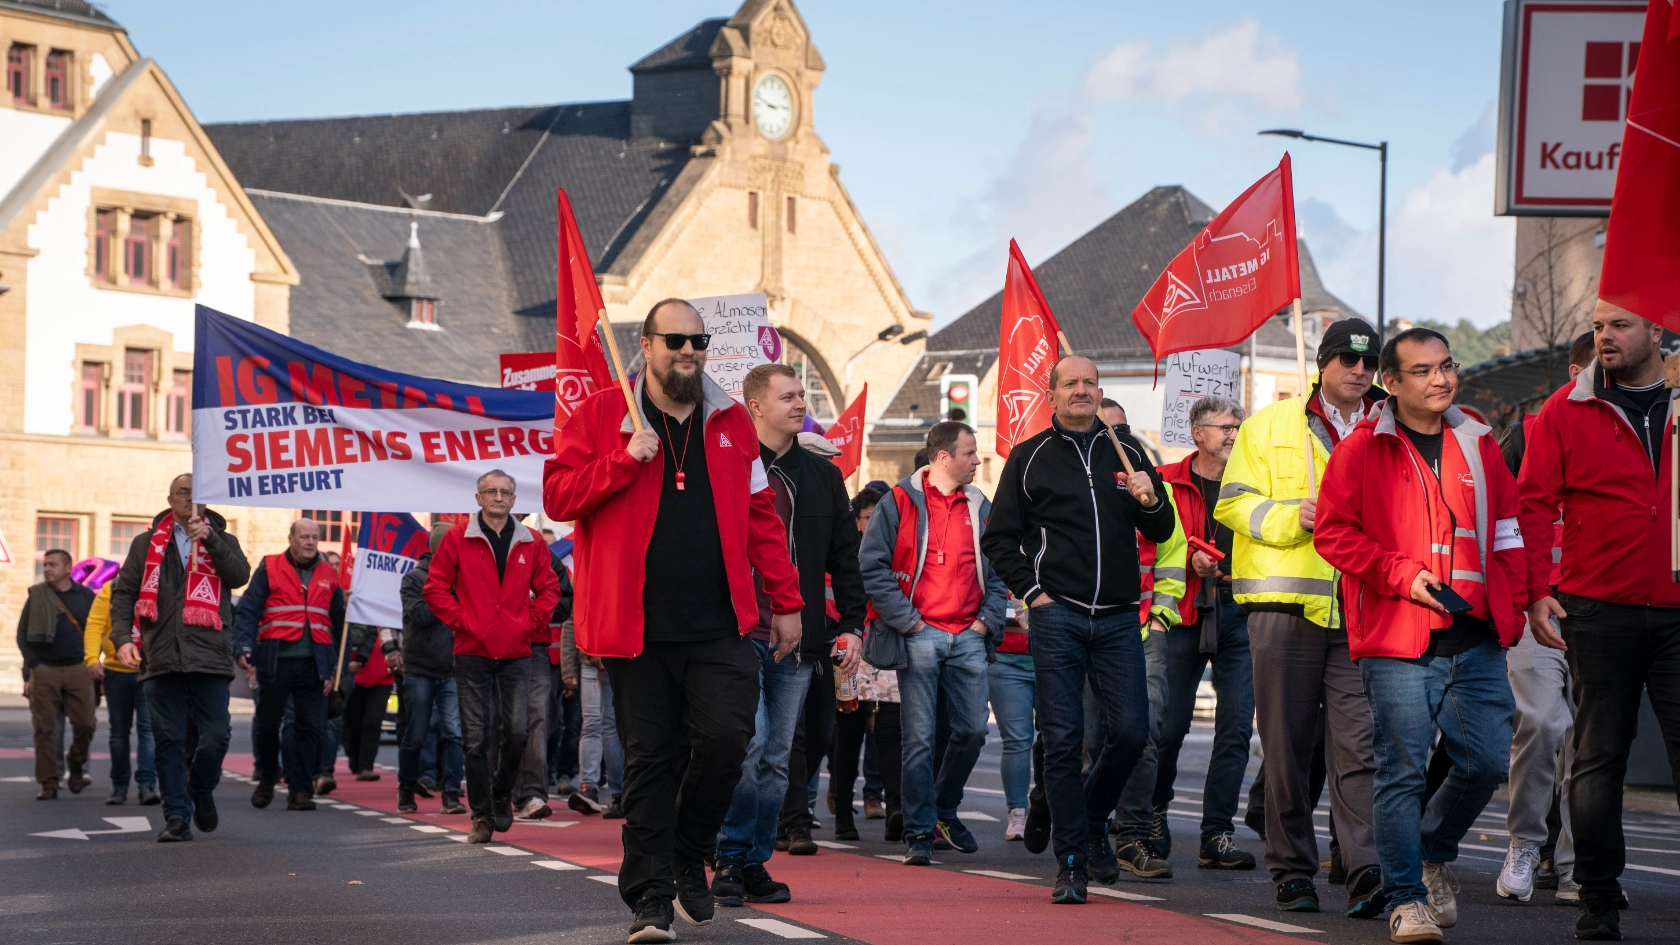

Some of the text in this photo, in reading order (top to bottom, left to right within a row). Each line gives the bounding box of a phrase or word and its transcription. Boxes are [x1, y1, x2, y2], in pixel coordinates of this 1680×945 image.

[1540, 142, 1622, 170] Kauf
[706, 340, 759, 359] rhöhung
[215, 354, 279, 408] IG
[503, 364, 557, 388] Zusamme
[1165, 394, 1196, 413] Wei
[223, 405, 338, 430] STARK BEI
[225, 426, 556, 473] SIEMENS ENERG
[1164, 430, 1196, 446] erse
[228, 469, 344, 498] IN ERFURT
[367, 511, 402, 554] IG
[366, 552, 399, 574] STARK
